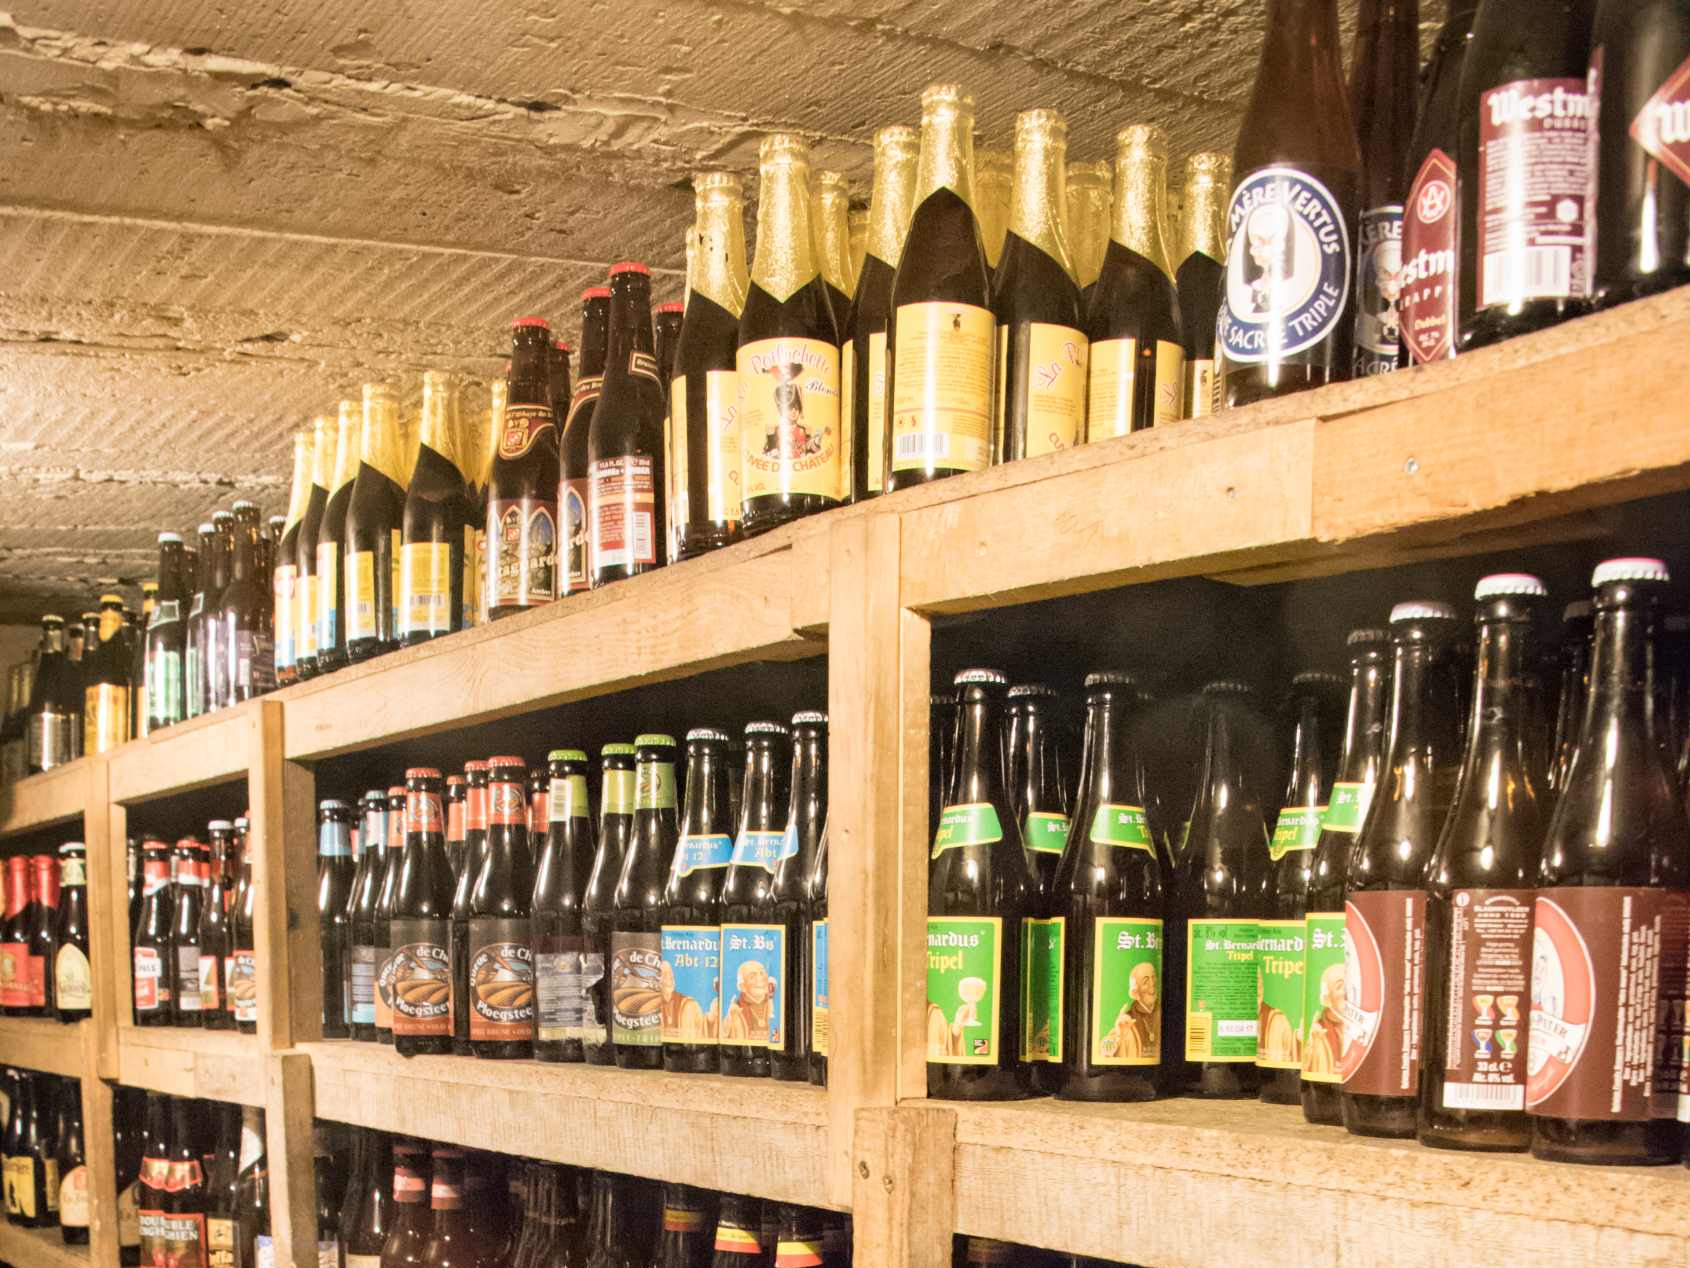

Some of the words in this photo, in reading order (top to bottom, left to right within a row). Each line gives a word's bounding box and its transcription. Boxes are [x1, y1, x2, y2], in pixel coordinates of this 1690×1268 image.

[1231, 183, 1278, 233] MÈRE
[1280, 180, 1341, 255] VERTUS
[1287, 281, 1340, 338] TRIPLE
[415, 944, 432, 957] de
[500, 944, 516, 958] de
[629, 950, 645, 964] de
[674, 953, 699, 968] Abt
